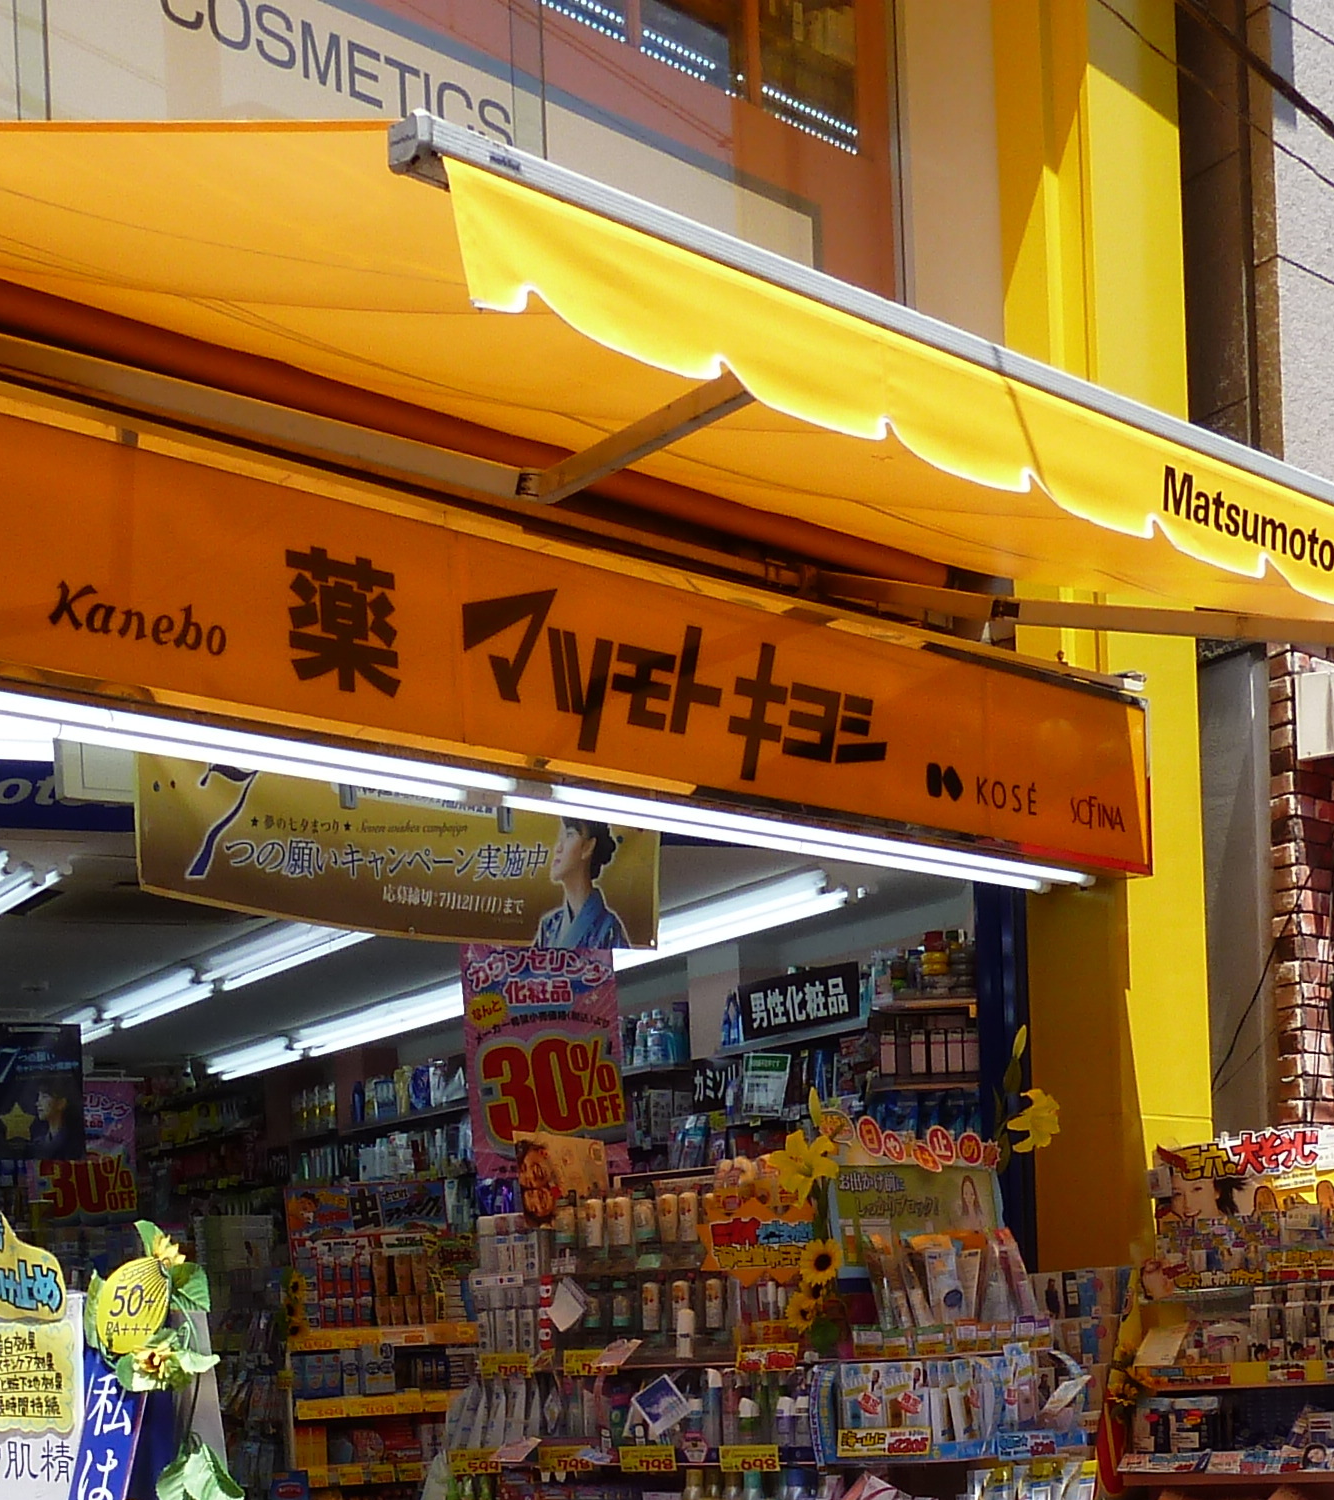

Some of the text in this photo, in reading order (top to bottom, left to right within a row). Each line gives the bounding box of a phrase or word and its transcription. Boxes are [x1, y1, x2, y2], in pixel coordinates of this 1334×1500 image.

[1161, 464, 1334, 575] Matsumoto
[48, 579, 228, 657] Kanebo
[285, 545, 402, 699] 薬
[461, 587, 890, 781] マツモトキヨシ
[1069, 796, 1127, 834] SOFINA
[749, 975, 849, 1031] 男性化粧品
[482, 1037, 625, 1142] 30% OFF
[637, 1457, 674, 1471] 798
